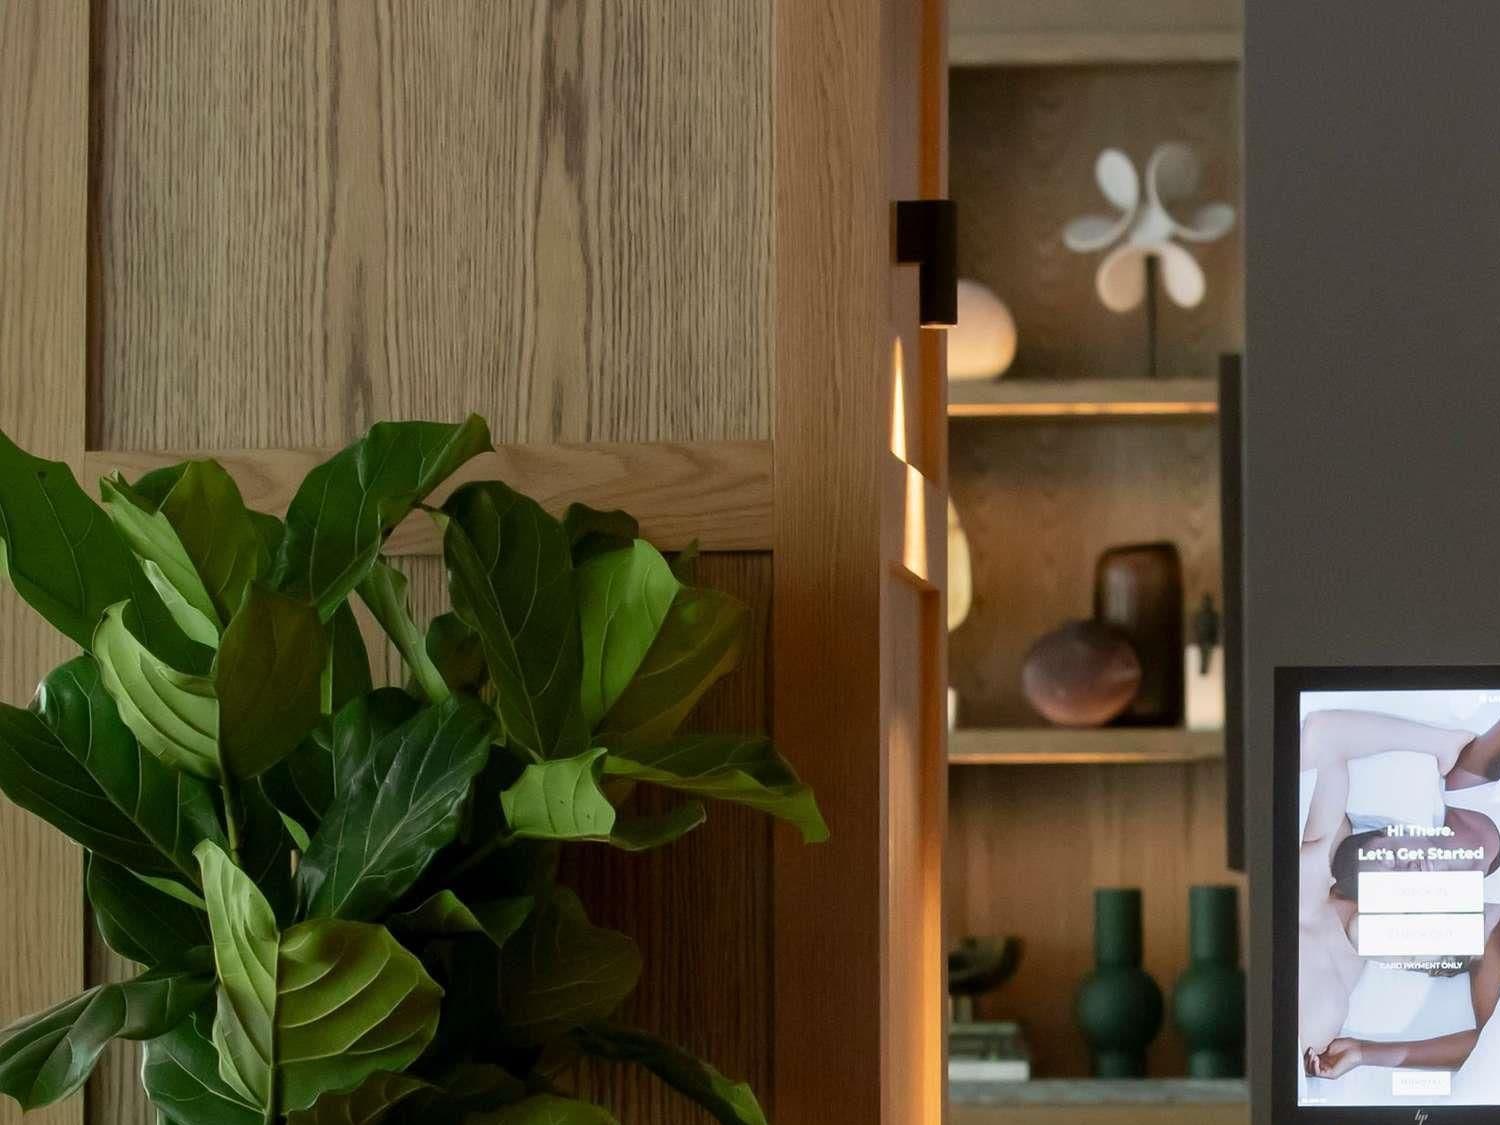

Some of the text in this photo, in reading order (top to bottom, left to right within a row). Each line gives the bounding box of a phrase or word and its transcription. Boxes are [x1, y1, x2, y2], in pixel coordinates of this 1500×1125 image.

[1387, 825, 1455, 837] Hi There.
[1358, 846, 1484, 861] Let's Get Started
[1403, 961, 1440, 969] PAYMENT
[1441, 961, 1463, 969] ONLY
